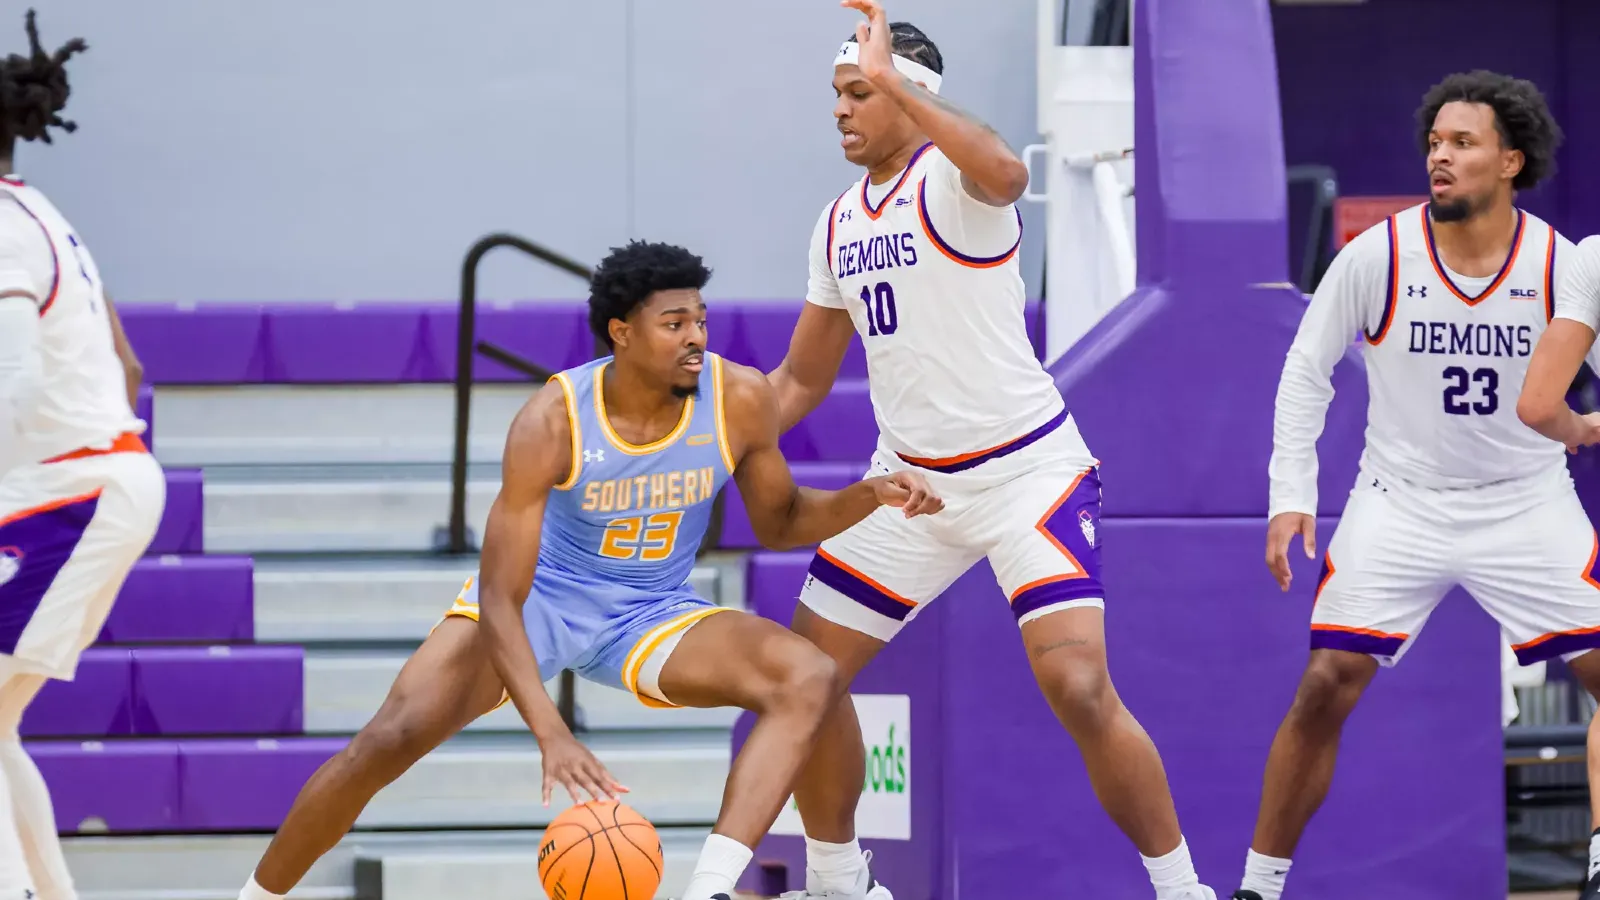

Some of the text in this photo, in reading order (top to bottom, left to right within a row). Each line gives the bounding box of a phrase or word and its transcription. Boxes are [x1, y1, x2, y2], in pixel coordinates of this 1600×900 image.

[838, 232, 918, 278] DEMONS
[860, 281, 898, 336] 10
[1509, 288, 1538, 297] SLC
[1408, 321, 1531, 357] DEMONS
[1442, 366, 1499, 415] 23
[581, 466, 714, 512] SOUTHERN
[598, 511, 685, 561] 23
